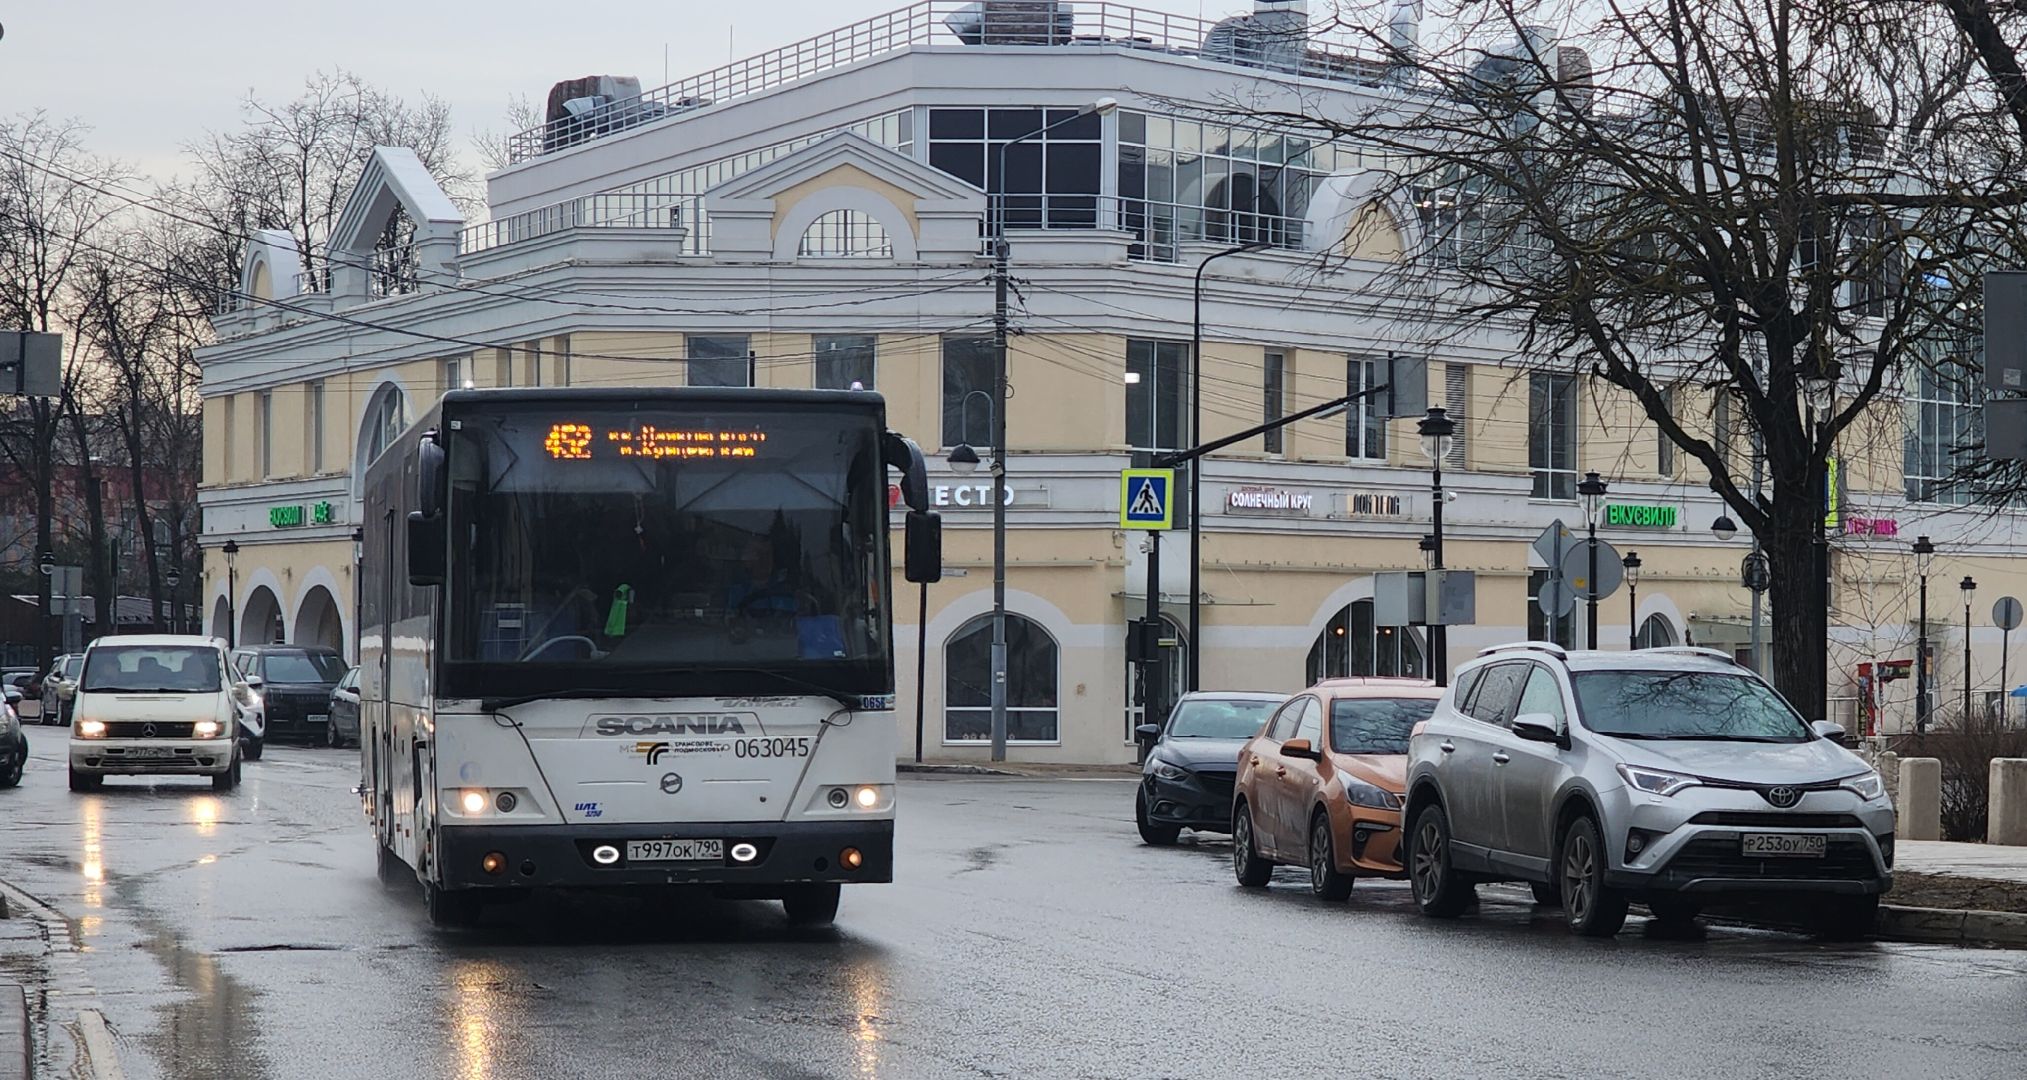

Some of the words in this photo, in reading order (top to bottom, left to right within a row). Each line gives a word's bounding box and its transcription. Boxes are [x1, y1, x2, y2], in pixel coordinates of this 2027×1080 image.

[545, 425, 592, 459] 452
[935, 485, 1015, 506] ЕСТО
[1231, 491, 1289, 508] СОЛНЕЧНЫЙ
[1291, 494, 1313, 510] КРУГ
[1608, 504, 1676, 527] ВКУСВИЛЛ
[596, 716, 745, 736] SCANIA
[735, 738, 809, 758] 063045
